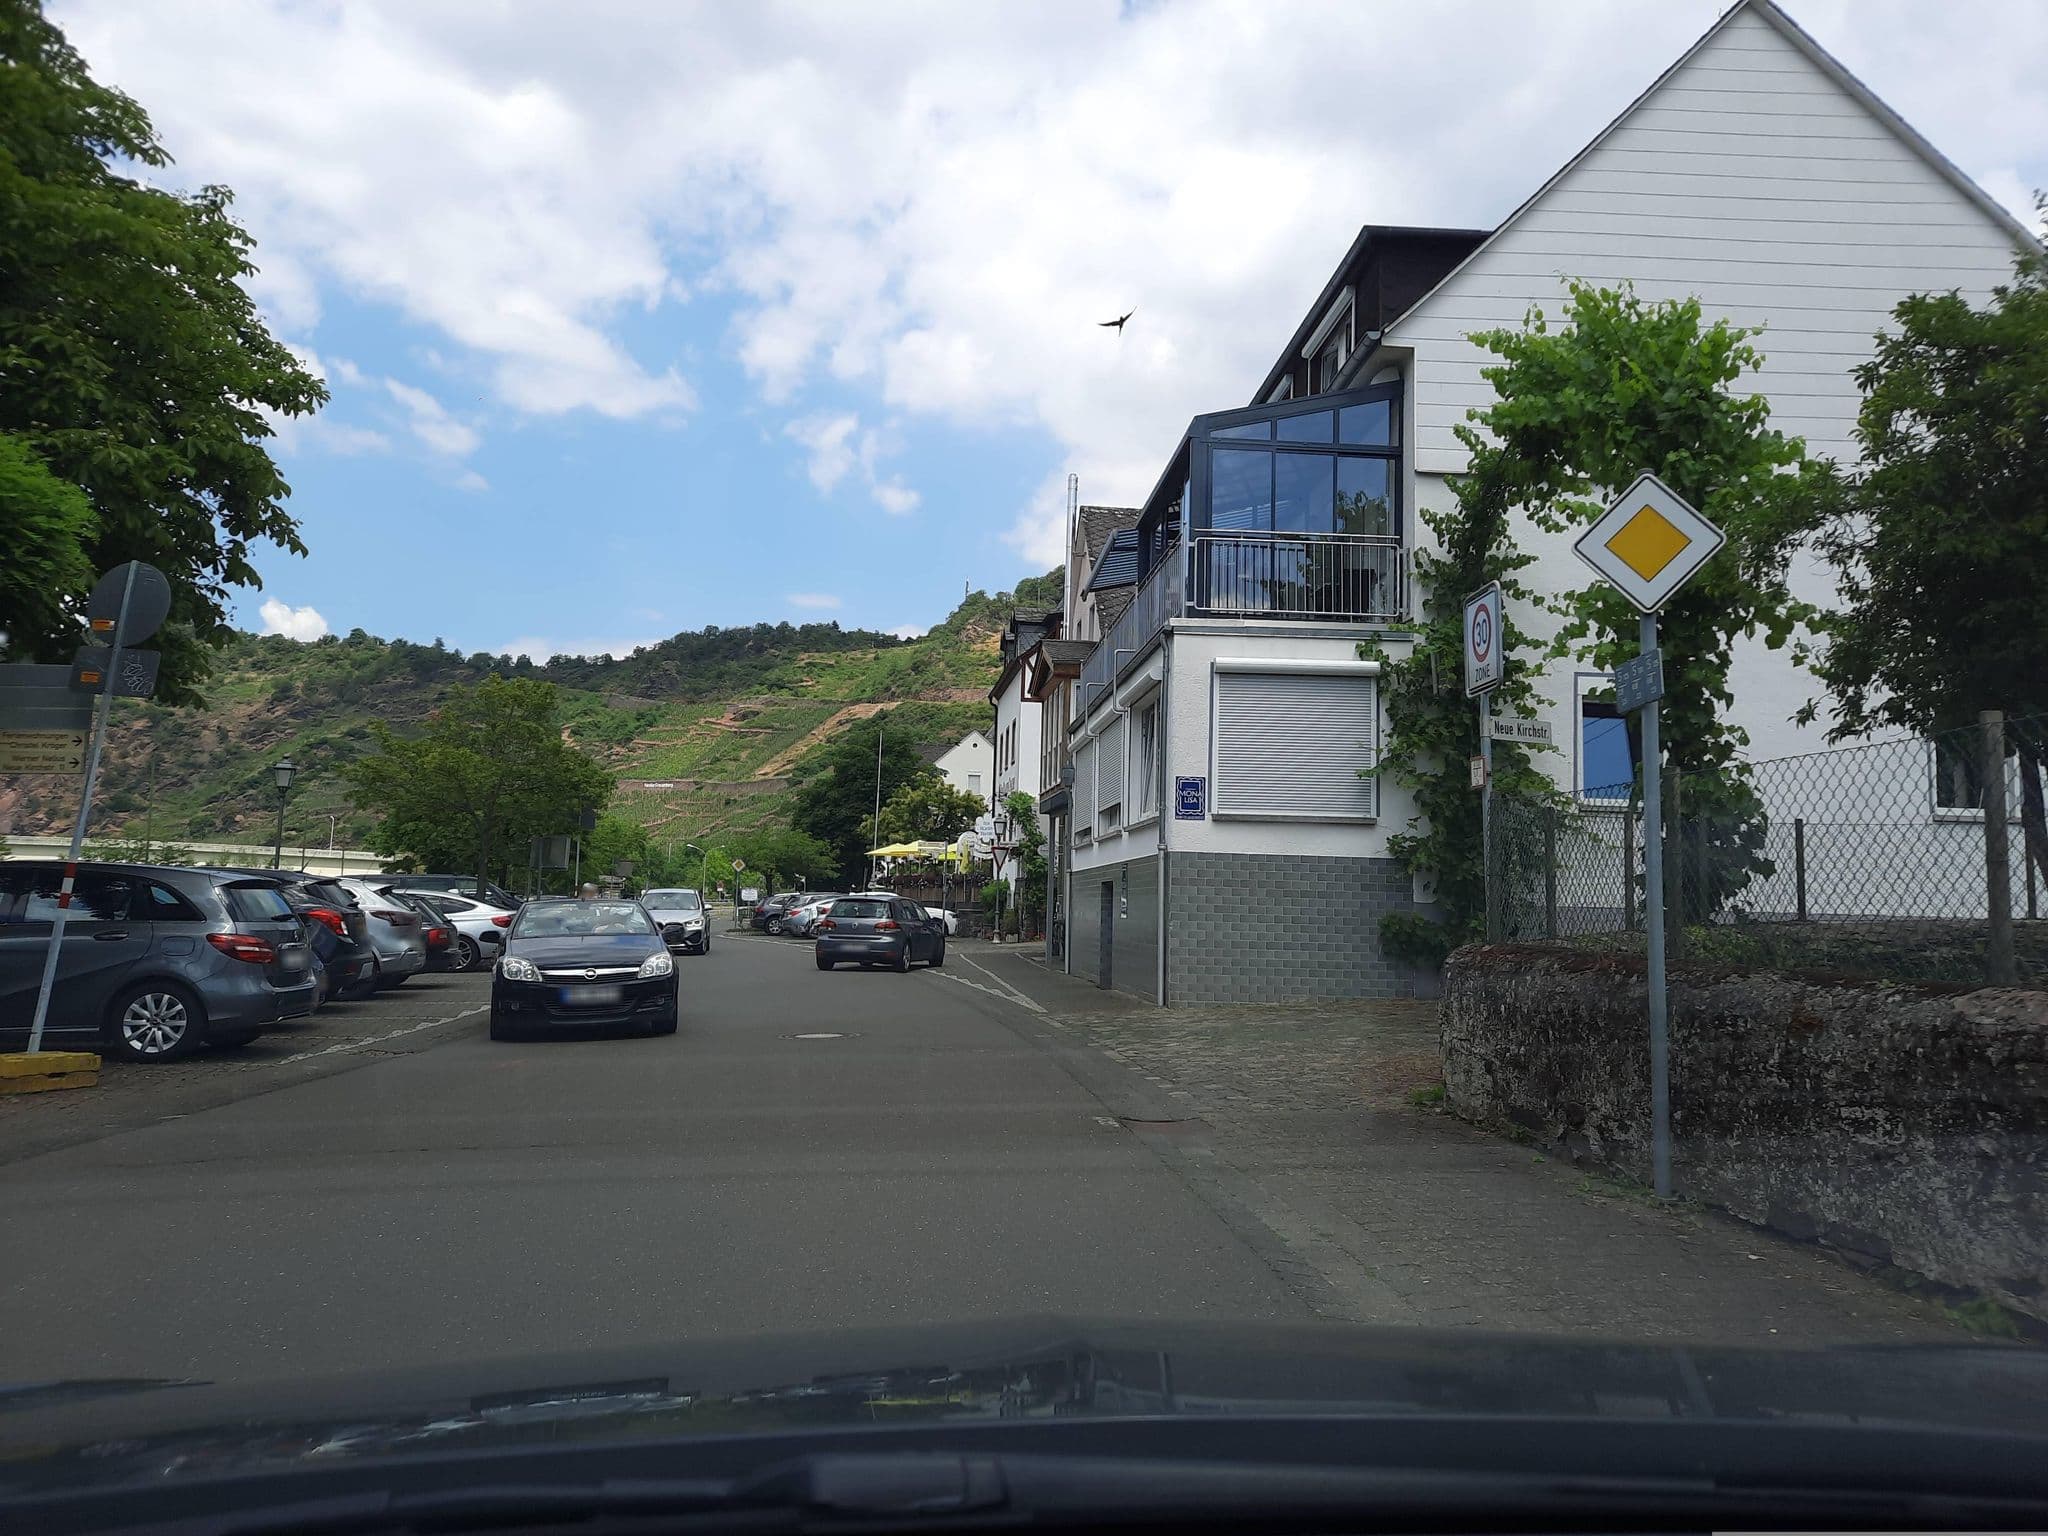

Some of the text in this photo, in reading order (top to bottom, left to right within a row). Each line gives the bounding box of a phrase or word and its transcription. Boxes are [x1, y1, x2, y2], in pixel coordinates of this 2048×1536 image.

[1476, 619, 1488, 648] 30
[1475, 664, 1490, 683] ZONE
[1494, 720, 1549, 739] Neue Kirchstr.
